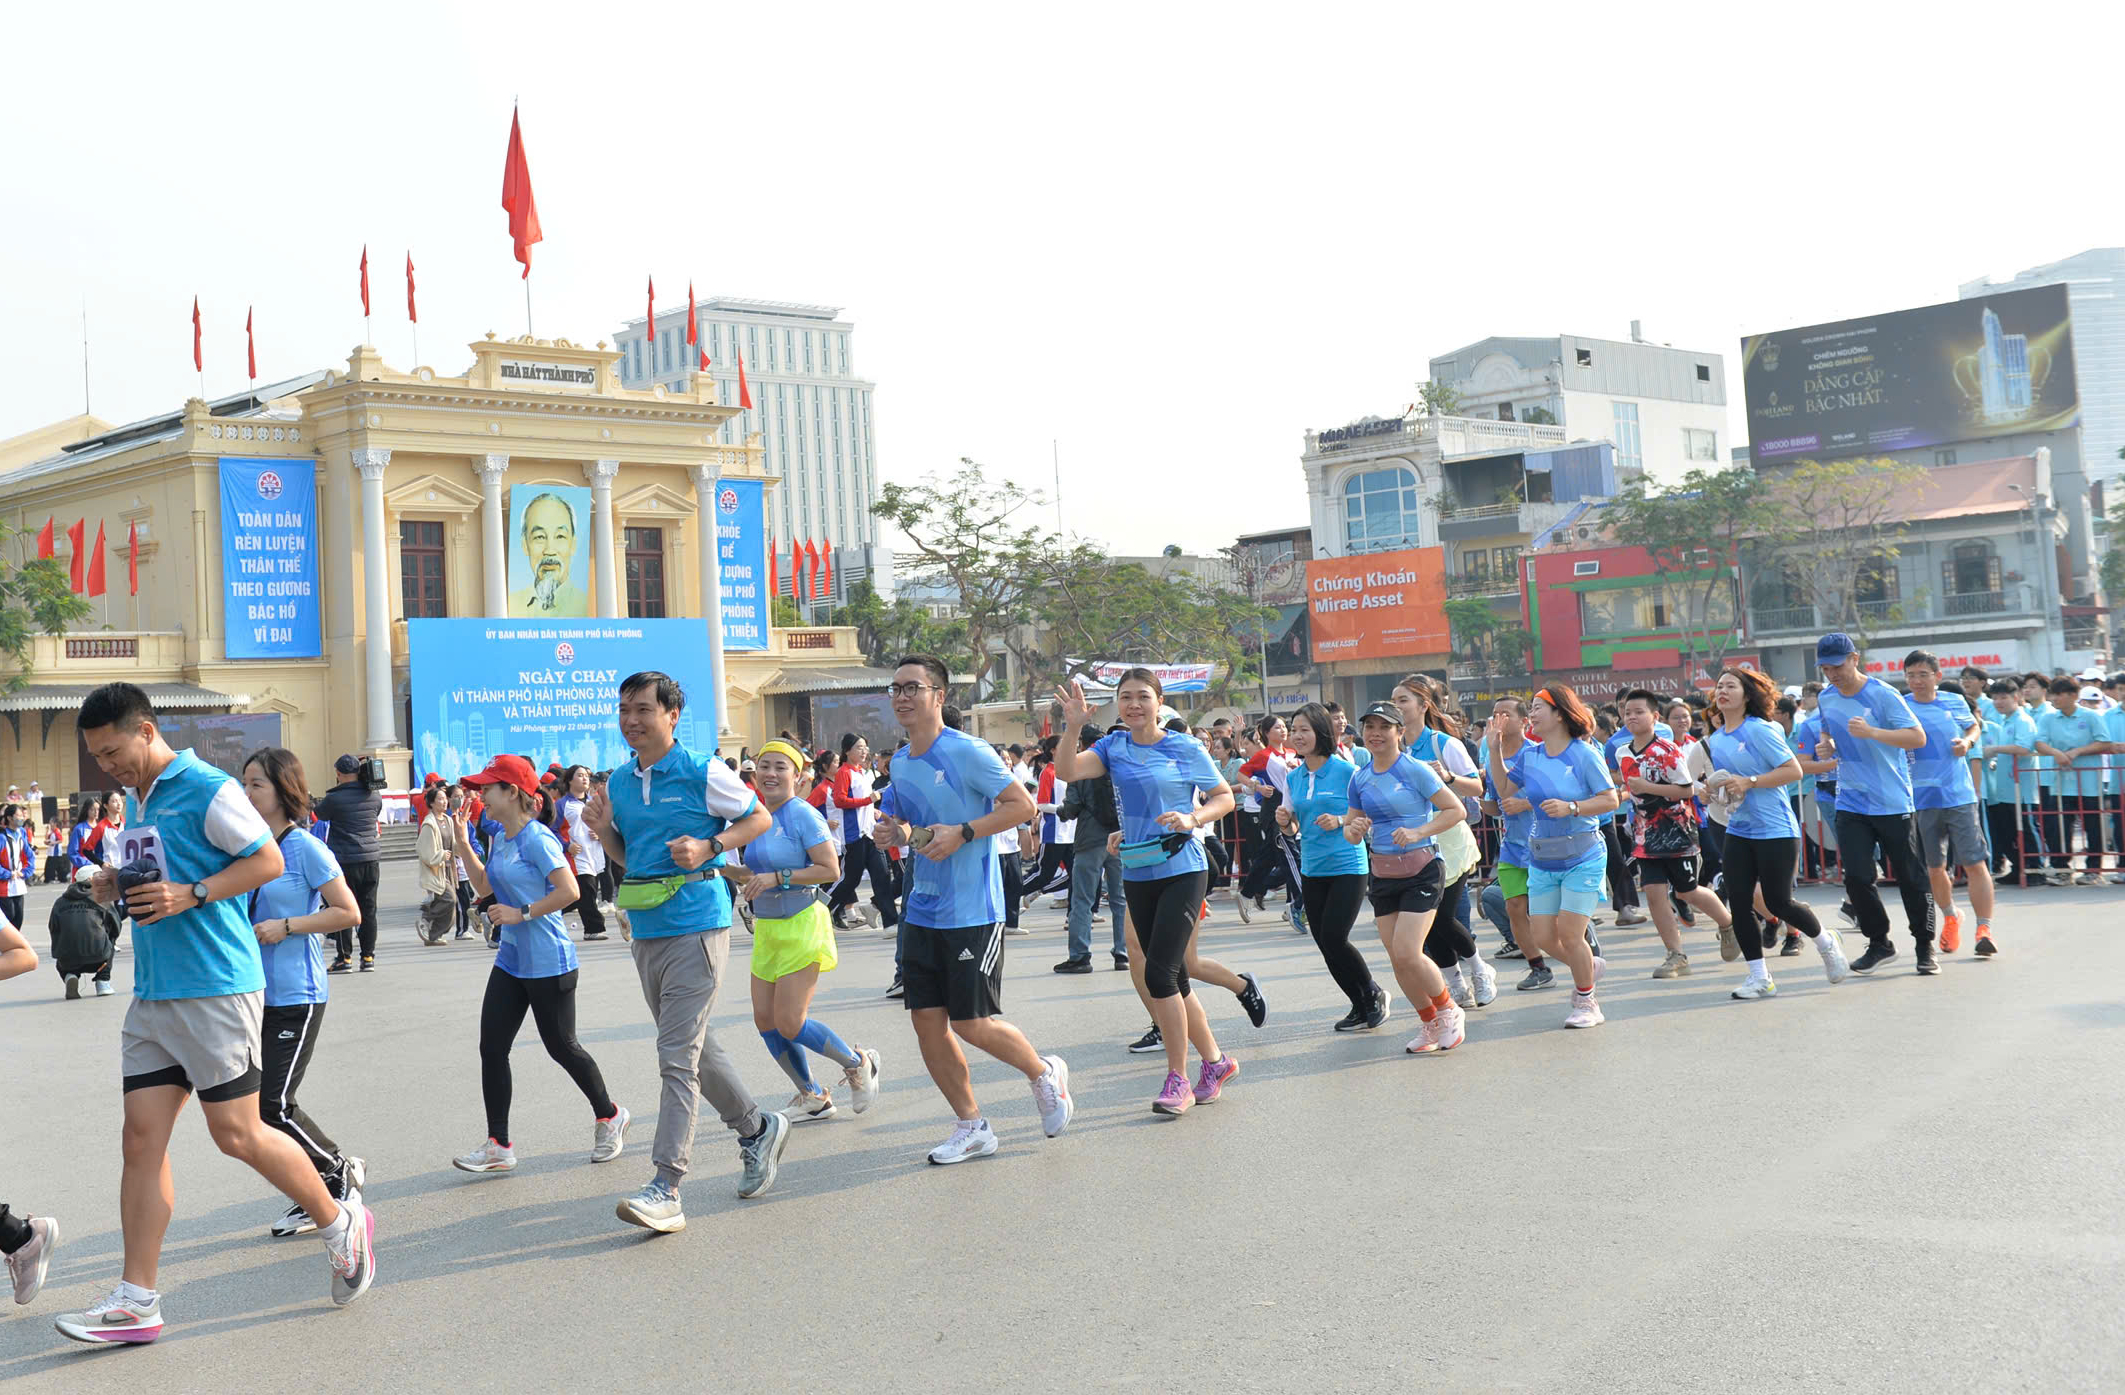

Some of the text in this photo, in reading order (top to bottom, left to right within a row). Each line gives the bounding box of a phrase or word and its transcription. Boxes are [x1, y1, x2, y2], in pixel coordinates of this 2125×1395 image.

[501, 362, 596, 384] NHÀ HÁT THÀNH PHỐ
[237, 510, 302, 528] TOÀN DÂN
[235, 533, 305, 554] RÈN LUYỆN
[240, 553, 301, 573] THÂN THỂ
[724, 565, 752, 581] DỰNG
[1313, 567, 1417, 592] Chứng Khoán
[231, 580, 311, 597] THEO GƯƠNG
[735, 582, 756, 598] PHỐ
[248, 600, 296, 620] BÁC HỒ
[722, 602, 756, 618] PHÒNG
[1315, 591, 1404, 613] Mirae Asset
[254, 626, 292, 645] VĨ ĐẠI
[498, 630, 515, 639] BAN
[517, 628, 539, 639] NHÂN
[541, 628, 557, 639] DÂN
[558, 628, 584, 639] THÀNH
[585, 627, 601, 639] PHỐ
[602, 627, 615, 638] HẢI
[616, 628, 643, 638] PHÒNG
[730, 622, 758, 641] THIỆN
[519, 668, 618, 685] NGÀY CHẠY
[1572, 672, 1607, 682] COFFEE
[452, 685, 619, 703] VÌ THÀNH PHỐ HẢI PHÒNG XAN
[1572, 682, 1618, 696] TRUNG
[503, 703, 518, 719] VÀ
[521, 702, 552, 718] THÂN
[554, 701, 586, 719] THIỆN
[589, 700, 613, 716] NĂM
[510, 723, 522, 733] Hải
[549, 724, 566, 733] ngày
[567, 723, 576, 731] 22
[577, 722, 596, 732] tháng
[1682, 860, 1694, 875] 4
